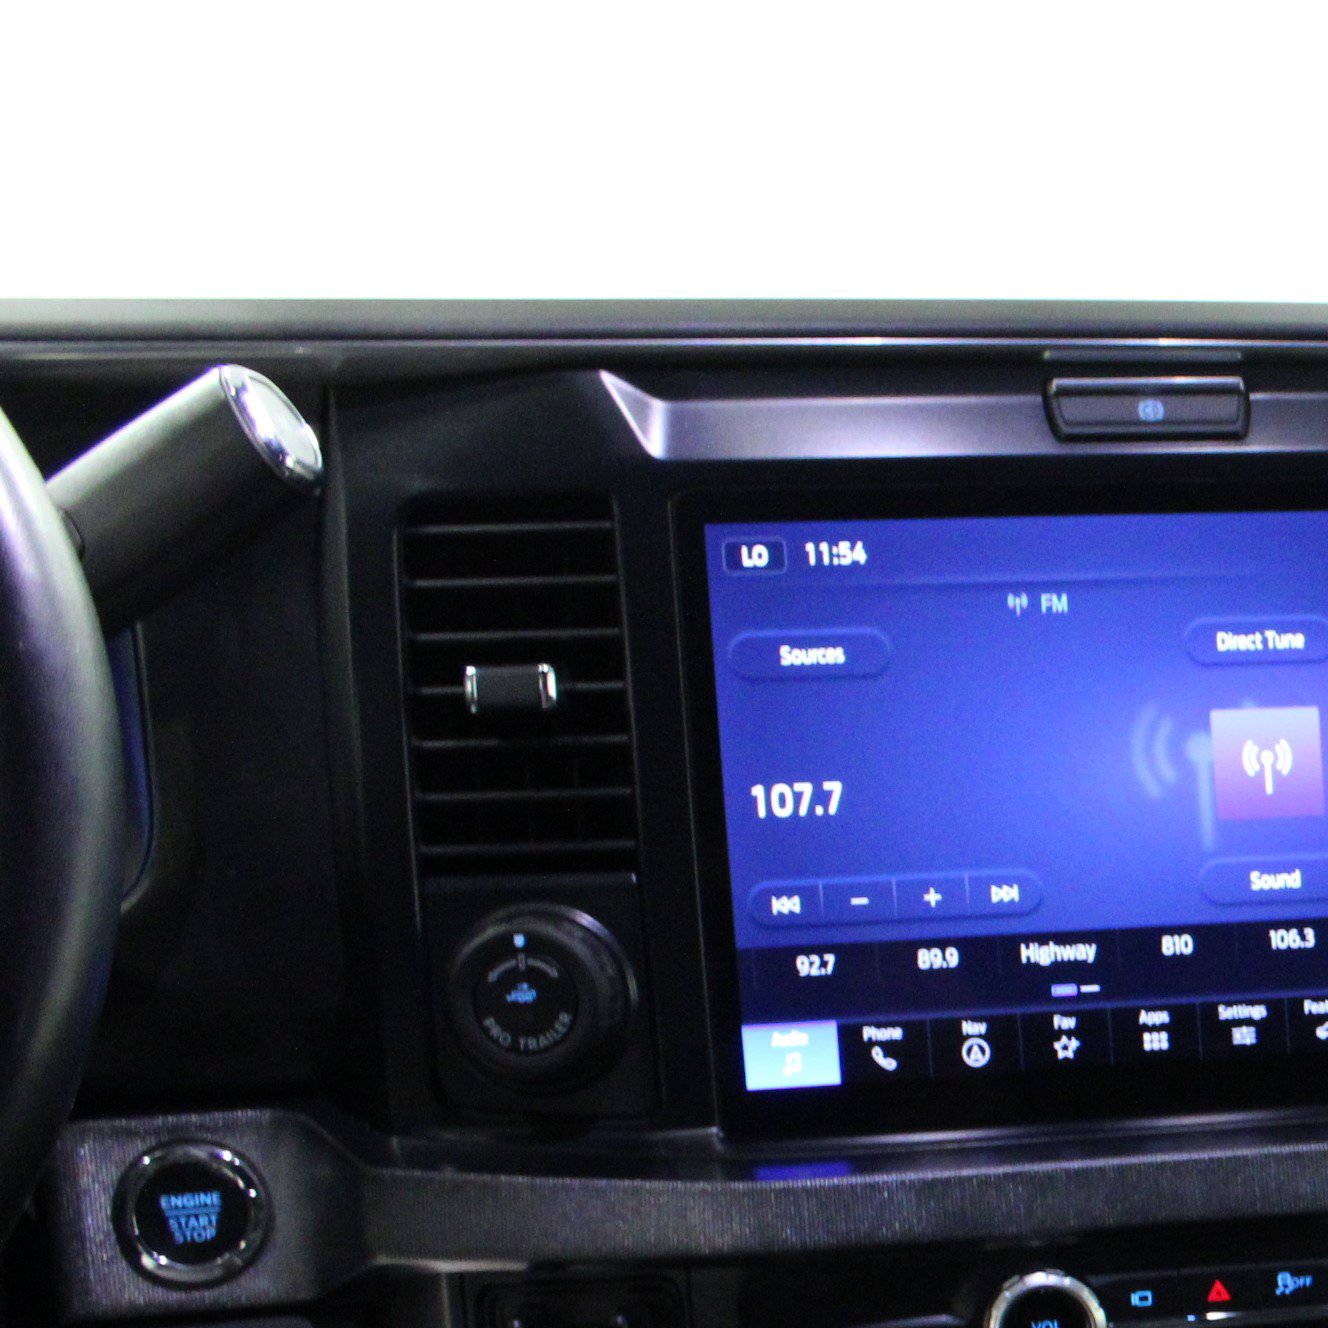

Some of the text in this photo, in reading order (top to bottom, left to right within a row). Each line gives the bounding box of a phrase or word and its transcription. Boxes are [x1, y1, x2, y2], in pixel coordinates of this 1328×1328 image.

[741, 545, 768, 567] LO
[805, 541, 867, 566] 11:54
[1041, 593, 1069, 614] FM
[1216, 629, 1305, 652] Direct Tune
[779, 645, 845, 666] Sources
[751, 781, 842, 819] 107.7
[1250, 869, 1302, 891] Sound
[1161, 934, 1193, 957] 810
[1268, 928, 1315, 951] 106.3
[917, 947, 959, 970] 89.9
[1020, 941, 1097, 967] Highway
[796, 953, 835, 977] 92.7
[1053, 1014, 1076, 1030] Fav
[1139, 1008, 1170, 1026] Apps
[1217, 1003, 1267, 1021] Settings
[863, 1024, 903, 1042] Phone
[962, 1019, 987, 1036] Nav
[159, 1191, 221, 1209] ENGINE
[168, 1214, 218, 1230] START
[174, 1227, 216, 1245] STOP
[1292, 1275, 1313, 1288] OFF
